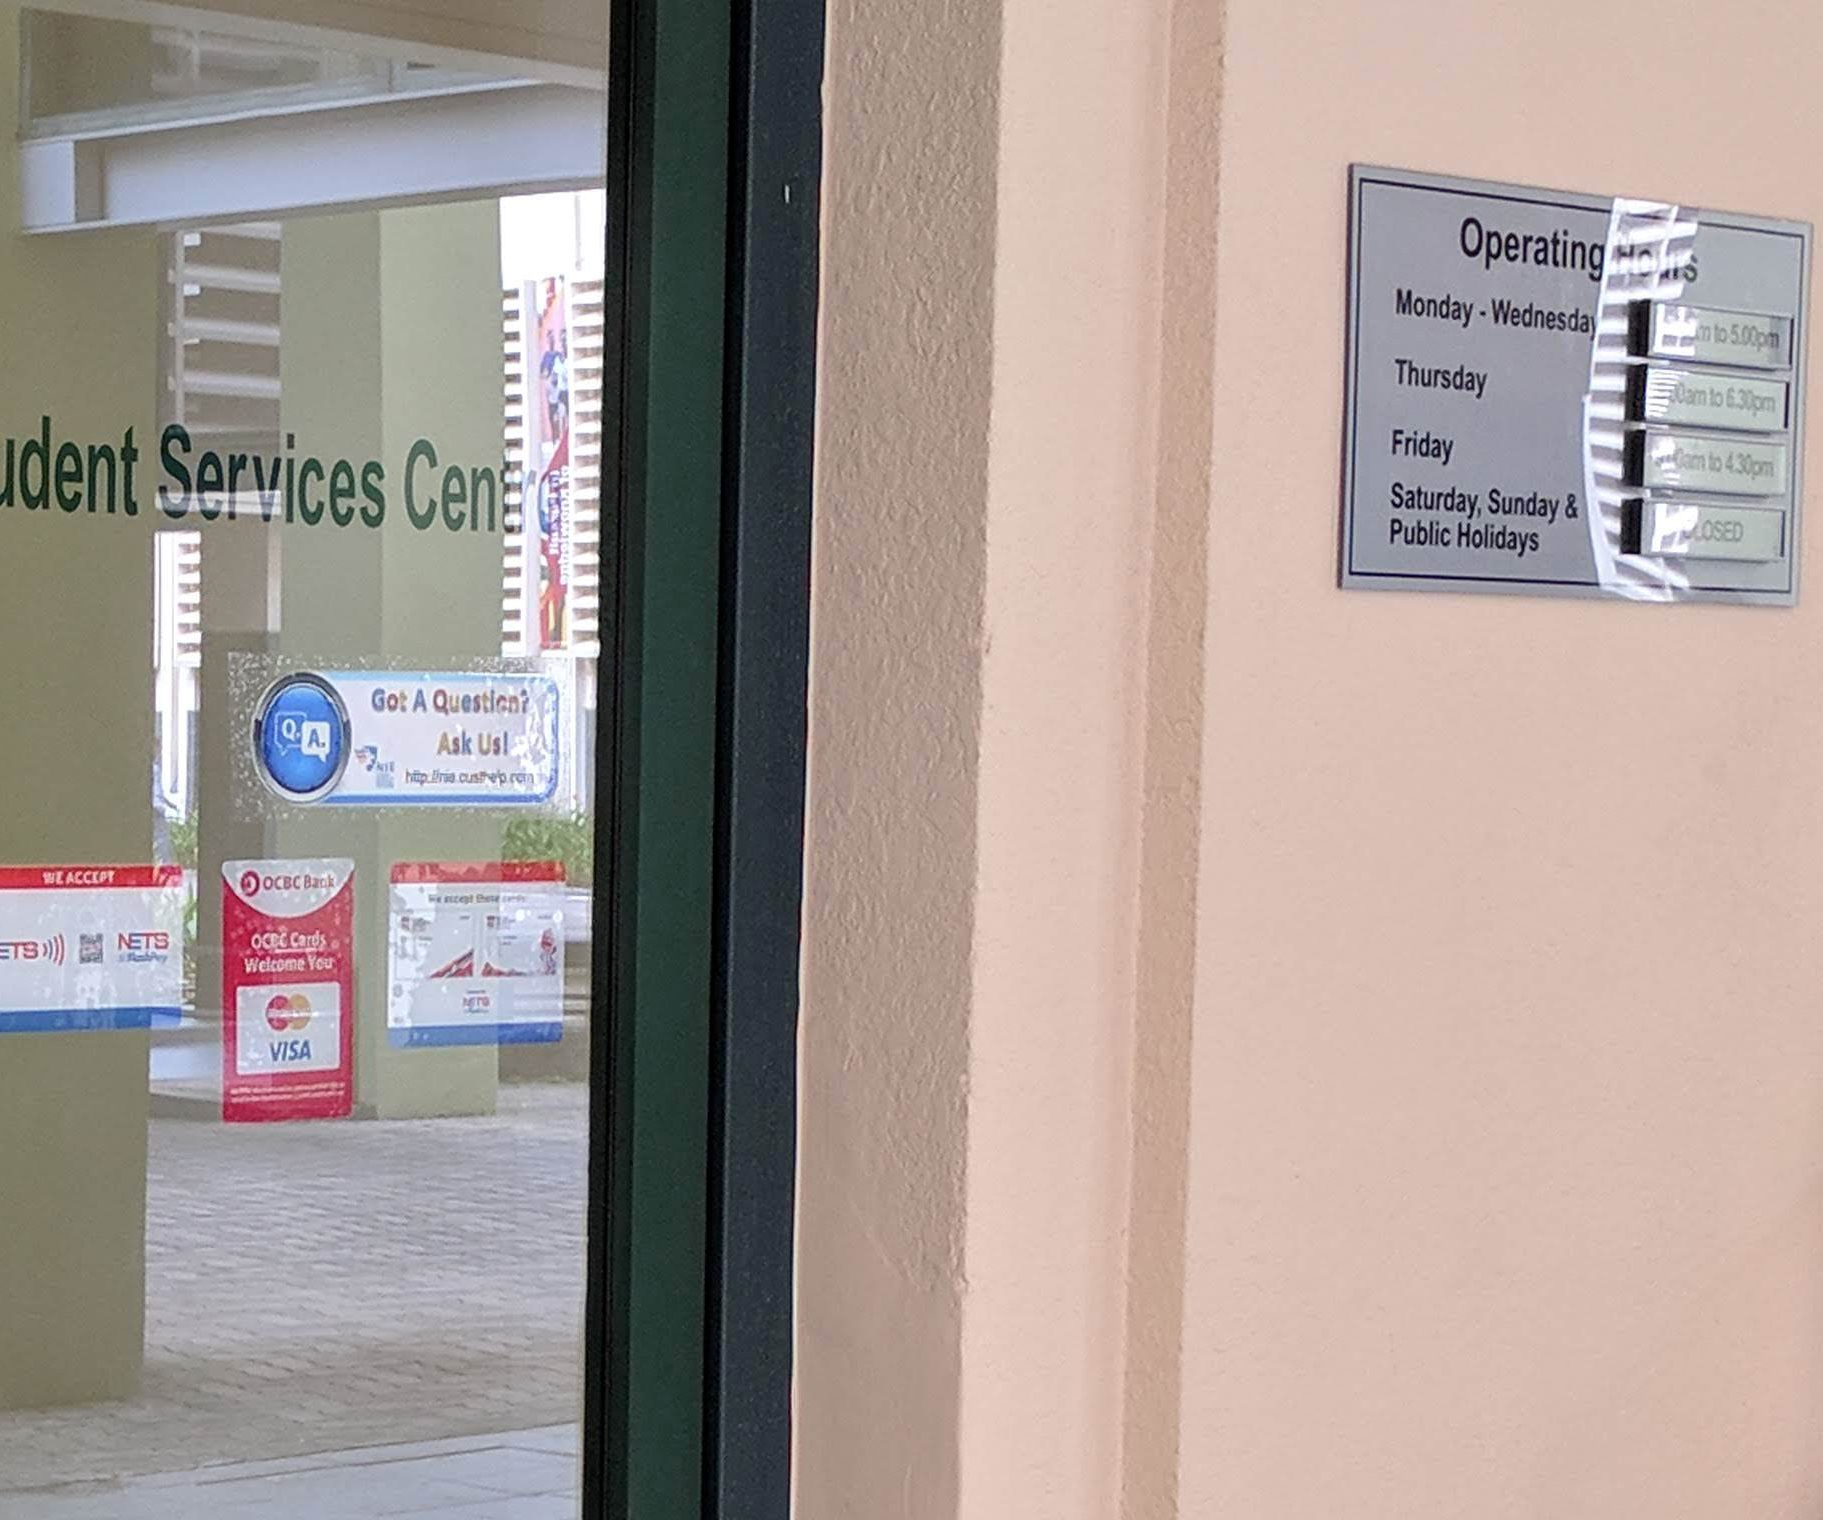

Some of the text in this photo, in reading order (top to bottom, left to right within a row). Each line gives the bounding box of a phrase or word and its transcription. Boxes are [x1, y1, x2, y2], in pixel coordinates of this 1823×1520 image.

[1460, 217, 1606, 282] Operating
[1396, 288, 1473, 328] Monday
[1492, 299, 1597, 341] Wednesday
[1395, 358, 1487, 399] Thursday
[1710, 387, 1724, 408] to
[1391, 429, 1453, 466] Friday
[1709, 451, 1722, 472] to
[159, 424, 385, 528] Services
[1390, 482, 1579, 525] Saturday, Sunday &
[1390, 518, 1540, 558] Public Holidays
[371, 688, 530, 716] Got A Question?
[436, 730, 509, 757] Ask Us!
[42, 870, 116, 886] WE ACCEPT
[263, 874, 335, 891] OCBC Bank
[118, 931, 170, 951] NETS
[251, 929, 327, 950] OCBC Cards
[244, 953, 334, 974] Welcome You
[269, 1039, 312, 1062] VISA
